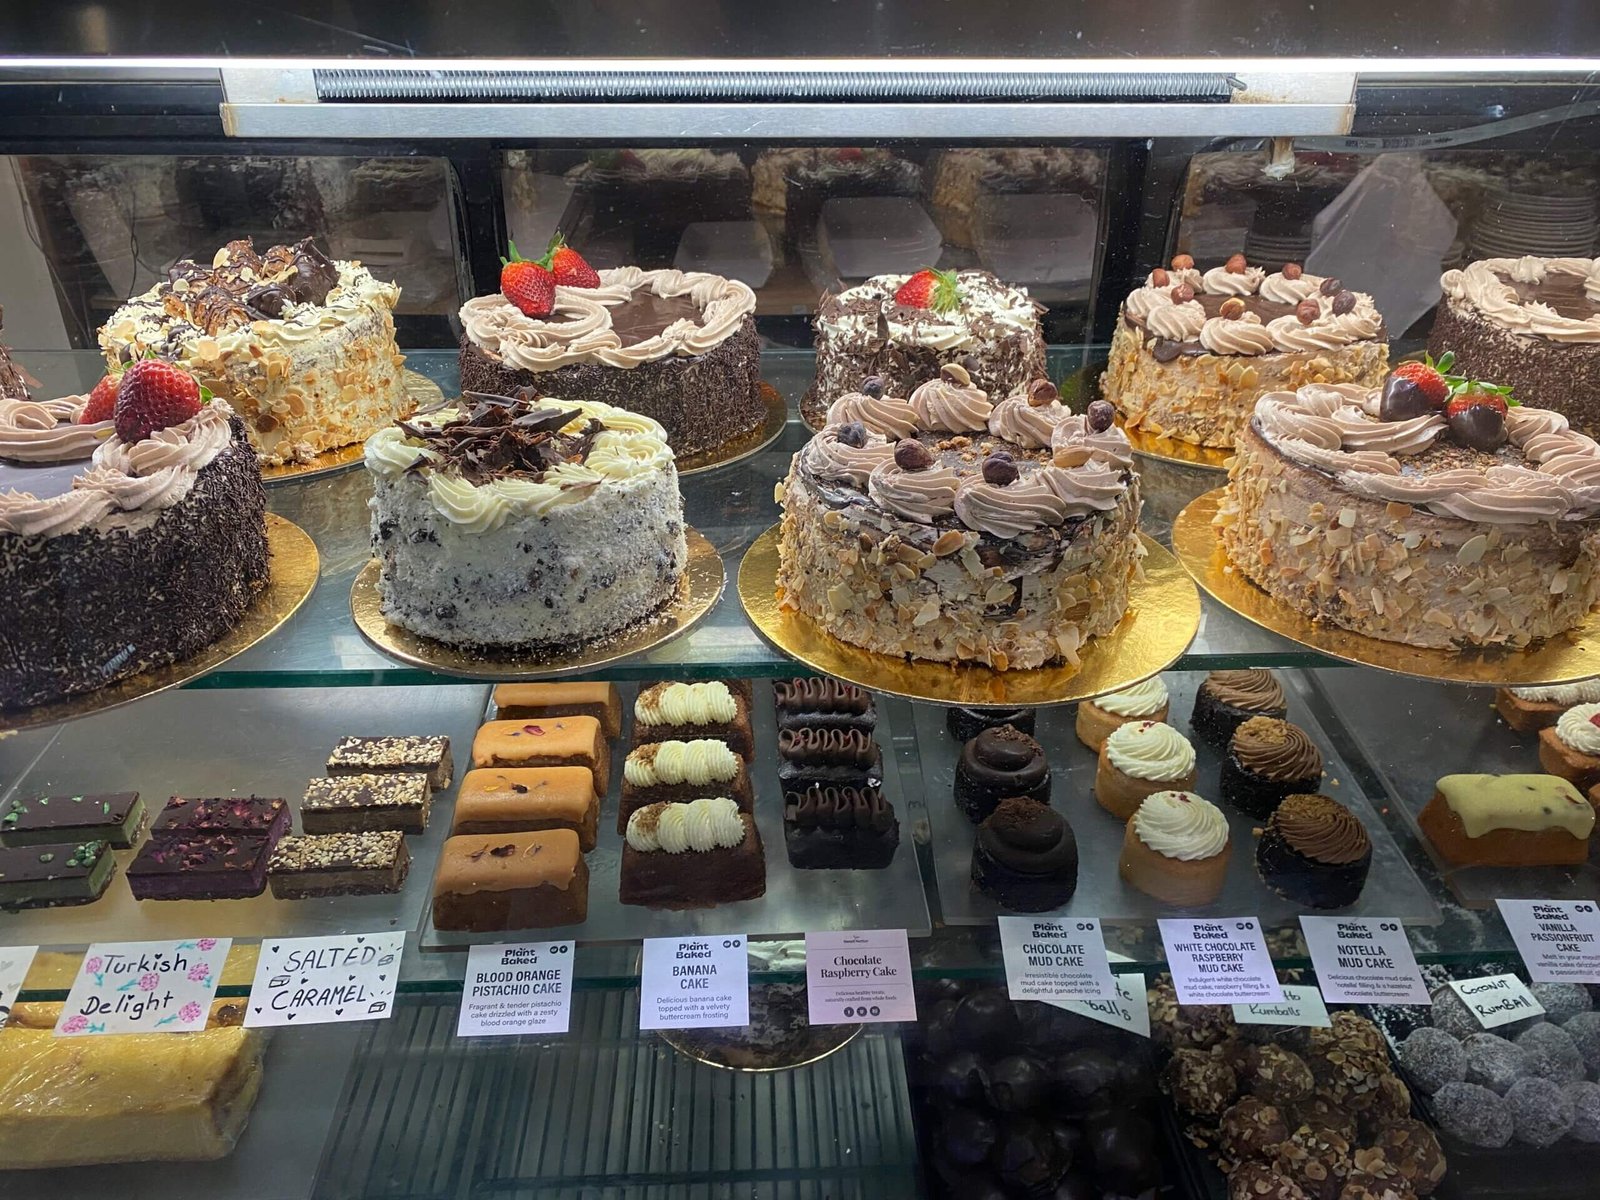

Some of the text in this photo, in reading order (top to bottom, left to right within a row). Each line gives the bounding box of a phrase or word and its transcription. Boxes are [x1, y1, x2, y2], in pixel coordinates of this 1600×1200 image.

[1193, 924, 1223, 932] Plant
[1337, 923, 1367, 931] Plant
[1531, 933, 1594, 942] PASSIONFRUIT
[1023, 944, 1085, 954] CHOCOLATE
[1174, 942, 1256, 952] WHITE CHOCOLATE
[1337, 945, 1386, 956] NOTELLA
[1556, 944, 1581, 952] CAKE
[505, 948, 535, 957] Plant
[1192, 953, 1243, 962] RASPBERRY
[104, 953, 187, 973] Turkish
[284, 946, 376, 972] SALTED
[501, 957, 537, 965] Baked
[834, 955, 881, 966] Chocolate
[1028, 957, 1084, 966] MUD CAKE
[1338, 958, 1394, 968] MUD CAKE
[673, 965, 717, 976] BANANA
[821, 966, 896, 979] Raspberry Cake
[1198, 964, 1244, 973] MUD CAKE
[477, 970, 560, 983] BLOOD ORANGE
[681, 978, 708, 989] CAKE
[472, 983, 561, 996] PISTACHIO CAKE
[272, 985, 366, 1010] CARAMEL
[80, 991, 173, 1021] Delight
